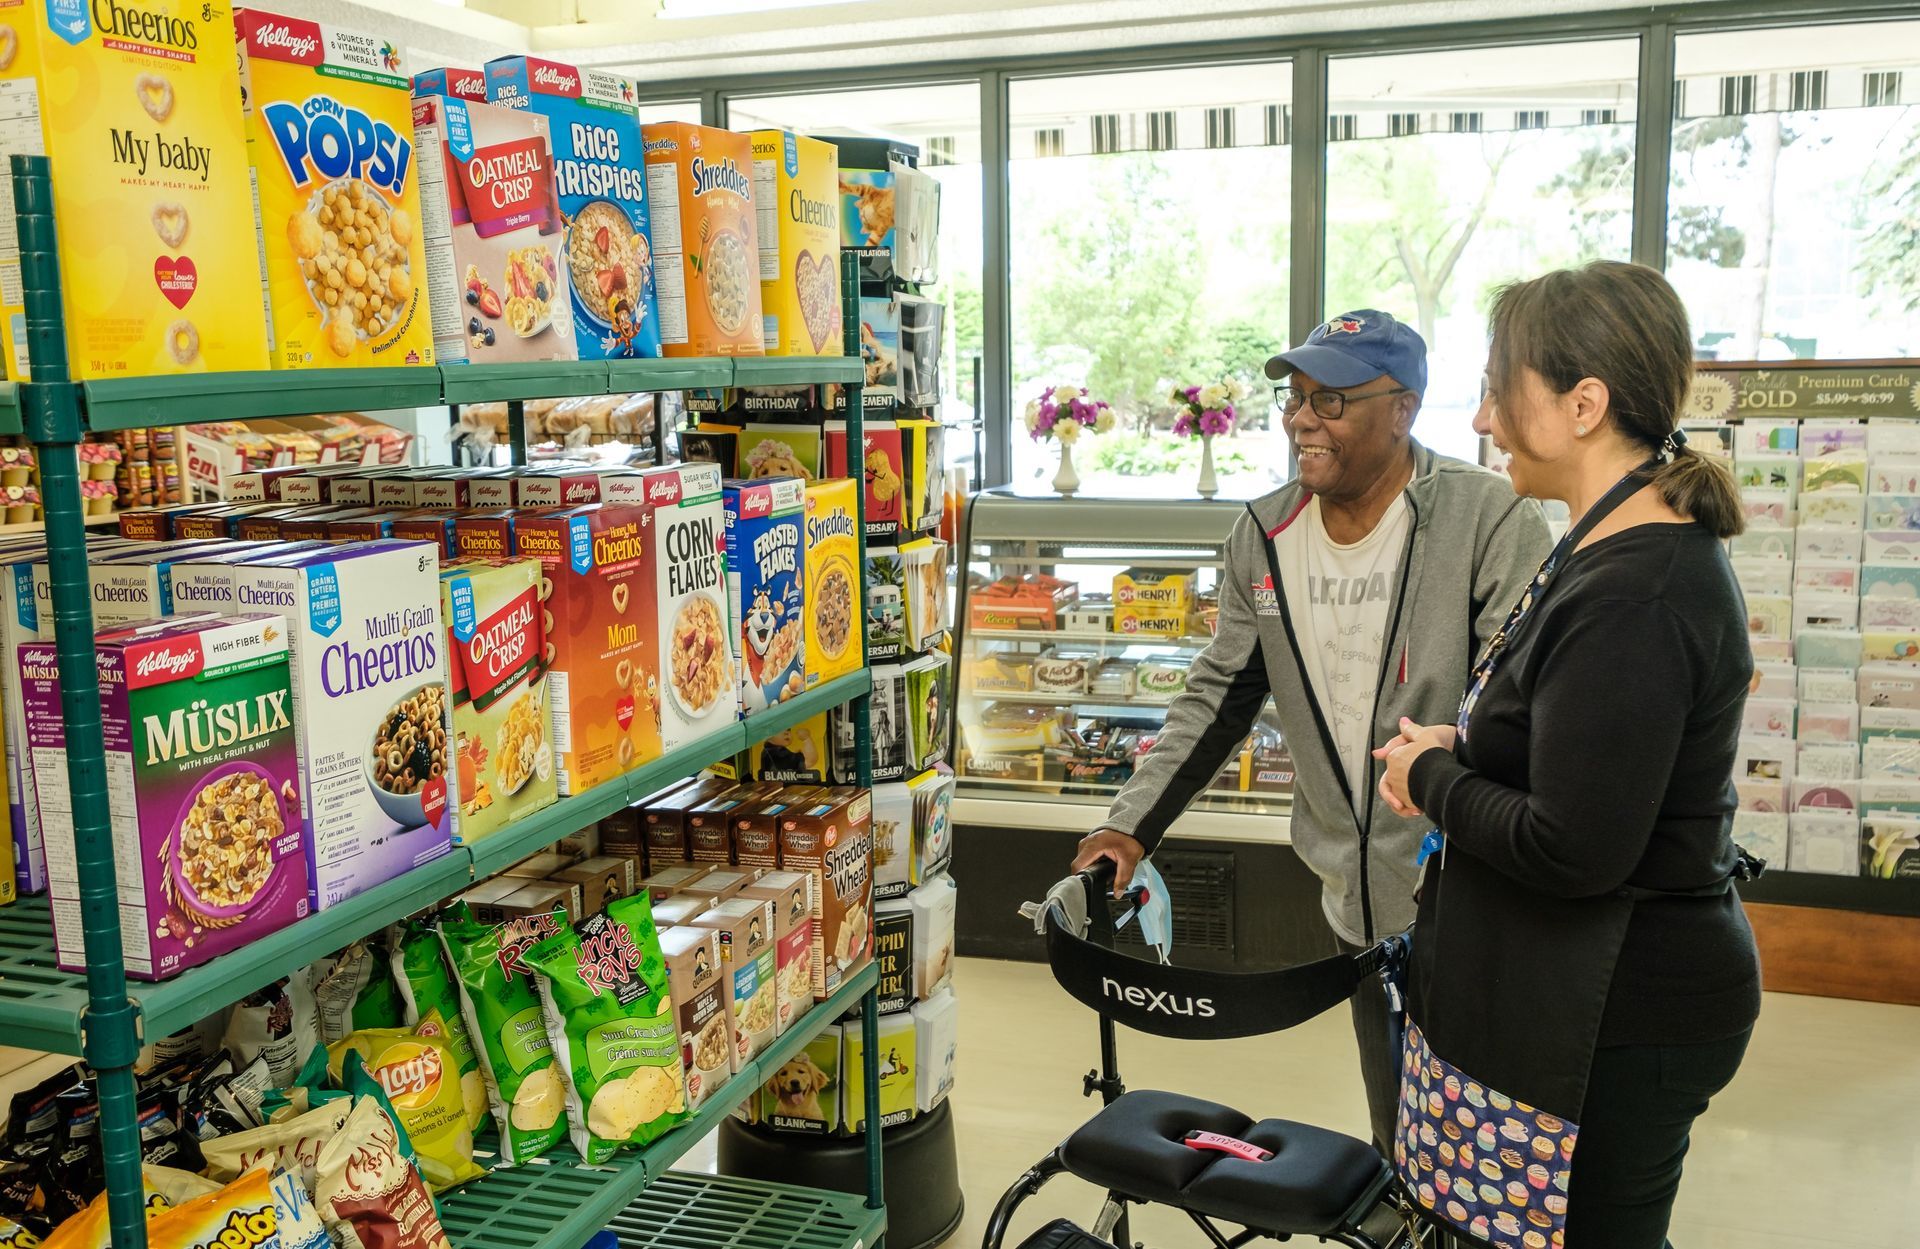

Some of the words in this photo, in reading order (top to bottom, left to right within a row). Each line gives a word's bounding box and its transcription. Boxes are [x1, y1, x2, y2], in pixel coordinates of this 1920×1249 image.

[92, 0, 198, 50] Cheerios
[255, 22, 317, 57] Kellogg's
[336, 33, 364, 45] SOURCE
[118, 42, 141, 53] HAPPY
[143, 46, 165, 56] HEART
[166, 50, 192, 62] SHAPES
[337, 43, 370, 55] VITAMINS
[122, 55, 151, 67] LIMITED
[153, 60, 182, 72] EDITION
[344, 54, 378, 66] MINERALS
[324, 67, 337, 75] MADE
[535, 66, 577, 91] Kellogg's
[303, 97, 344, 120] CORN
[446, 104, 466, 115] WHOLE
[448, 114, 467, 124] GRAIN
[452, 127, 467, 137] FIRST
[264, 103, 412, 194] POPS!
[571, 122, 620, 162] Rice
[643, 139, 678, 152] Shreddies
[751, 143, 776, 153] eerios
[110, 128, 150, 176] My
[156, 133, 211, 182] baby
[469, 149, 542, 188] OATMEAL
[120, 177, 147, 187] MAKES
[150, 180, 160, 188] MY
[163, 181, 186, 190] HEART
[188, 184, 210, 192] HAPPY
[692, 157, 750, 201] Shreddies
[491, 176, 533, 209] CRISP
[790, 189, 836, 230] Cheerios
[505, 216, 518, 227] Triple
[518, 214, 530, 224] Berry
[372, 332, 400, 354] Unlimited
[1798, 374, 1865, 389] Premium
[1868, 373, 1910, 388] Cards
[745, 397, 799, 409] BIRTHDAY
[836, 396, 893, 407] REMENT
[1695, 395, 1714, 411] $3
[1739, 390, 1797, 408] GOLD
[1816, 392, 1849, 405] $5.99
[1861, 392, 1895, 405] $6.99
[684, 474, 700, 484] SUGAR
[700, 472, 712, 480] WISE
[566, 483, 597, 501] Kellogg's
[649, 479, 679, 500] Kellogg's
[745, 491, 770, 512] Kellogg's
[126, 524, 155, 535] Cheerios
[183, 527, 215, 539] Cheerios
[472, 529, 488, 538] Honey
[489, 529, 499, 537] Nut
[530, 529, 548, 538] Honey
[548, 529, 559, 537] Nut
[572, 525, 588, 534] WHOLE
[610, 526, 627, 538] Honey
[627, 522, 638, 534] Nut
[807, 508, 854, 549] Shreddies
[866, 522, 898, 533] ERSARY
[461, 535, 501, 550] Cheerios
[520, 535, 560, 550] Cheerios
[575, 544, 588, 552] FIRST
[666, 517, 714, 564] CORN
[754, 524, 798, 563] FROSTED
[595, 537, 642, 566] Cheerios
[760, 547, 796, 585] FLAKES
[112, 577, 128, 586] Multi
[129, 577, 147, 588] Grain
[194, 576, 211, 584] Multi
[212, 576, 231, 587] Grain
[311, 576, 335, 587] GRAINS
[668, 555, 717, 597] FLAKES
[94, 583, 148, 603] Cheerios
[176, 582, 232, 602] Cheerios
[257, 580, 275, 589] Multi
[275, 580, 294, 591] Grain
[311, 586, 336, 596] ENTIERS
[452, 587, 471, 598] WHOLE
[238, 585, 296, 607] Cheerios
[455, 596, 471, 606] GRAIN
[1119, 588, 1137, 600] OH
[1137, 588, 1176, 601] HENRY!
[312, 599, 338, 611] PREMIER
[457, 609, 471, 618] FIRST
[365, 614, 400, 641] Multi
[403, 605, 434, 634] Grain
[1121, 618, 1138, 630] OH
[1139, 618, 1180, 632] HENRY!
[470, 601, 534, 664] OATMEAL
[607, 623, 637, 649] Mom
[213, 641, 234, 653] HIGH
[236, 634, 260, 648] FIBRE
[868, 644, 899, 656] ERSARY
[25, 650, 56, 665] Kellogg's
[488, 631, 526, 677] CRISP
[137, 648, 197, 676] Kellogg's
[204, 668, 224, 678] SOURCE
[224, 666, 231, 674] OF
[237, 660, 259, 671] VITAMINS
[263, 653, 285, 664] MINERALS
[320, 631, 436, 699] Cheerios
[143, 689, 290, 766] MÜSLIX
[179, 759, 201, 772] WITH
[202, 753, 223, 766] REAL
[225, 746, 247, 760] FRUIT
[248, 744, 254, 753] &
[255, 738, 271, 750] NUT
[315, 755, 336, 767] FAITES
[336, 752, 345, 761] DE
[316, 764, 338, 776] GRAINS
[338, 757, 361, 770] ENTIERS
[848, 765, 903, 780] AERSARY
[764, 771, 797, 780] BLANK
[1258, 772, 1293, 782] SNICKERS
[276, 831, 300, 848] ALMOND
[740, 833, 773, 842] Shredded
[744, 841, 768, 849] Wheat
[785, 833, 819, 842] Shredded
[279, 840, 299, 855] RAISIN
[790, 841, 814, 850] Wheat
[825, 826, 872, 879] Shredded
[834, 860, 868, 900] Wheat
[875, 884, 905, 896] ERSARY
[573, 919, 631, 967] uncle
[747, 939, 765, 956] QUAKER
[876, 932, 905, 952] PPILY
[160, 953, 173, 967] 450
[693, 970, 712, 989] QUAKER
[515, 1019, 536, 1036] Sour
[601, 1031, 625, 1042] Sour
[379, 1049, 440, 1098] Lay's
[423, 1104, 446, 1120] Pickle
[774, 1117, 806, 1128] BLANK
[519, 1138, 537, 1147] POTATO
